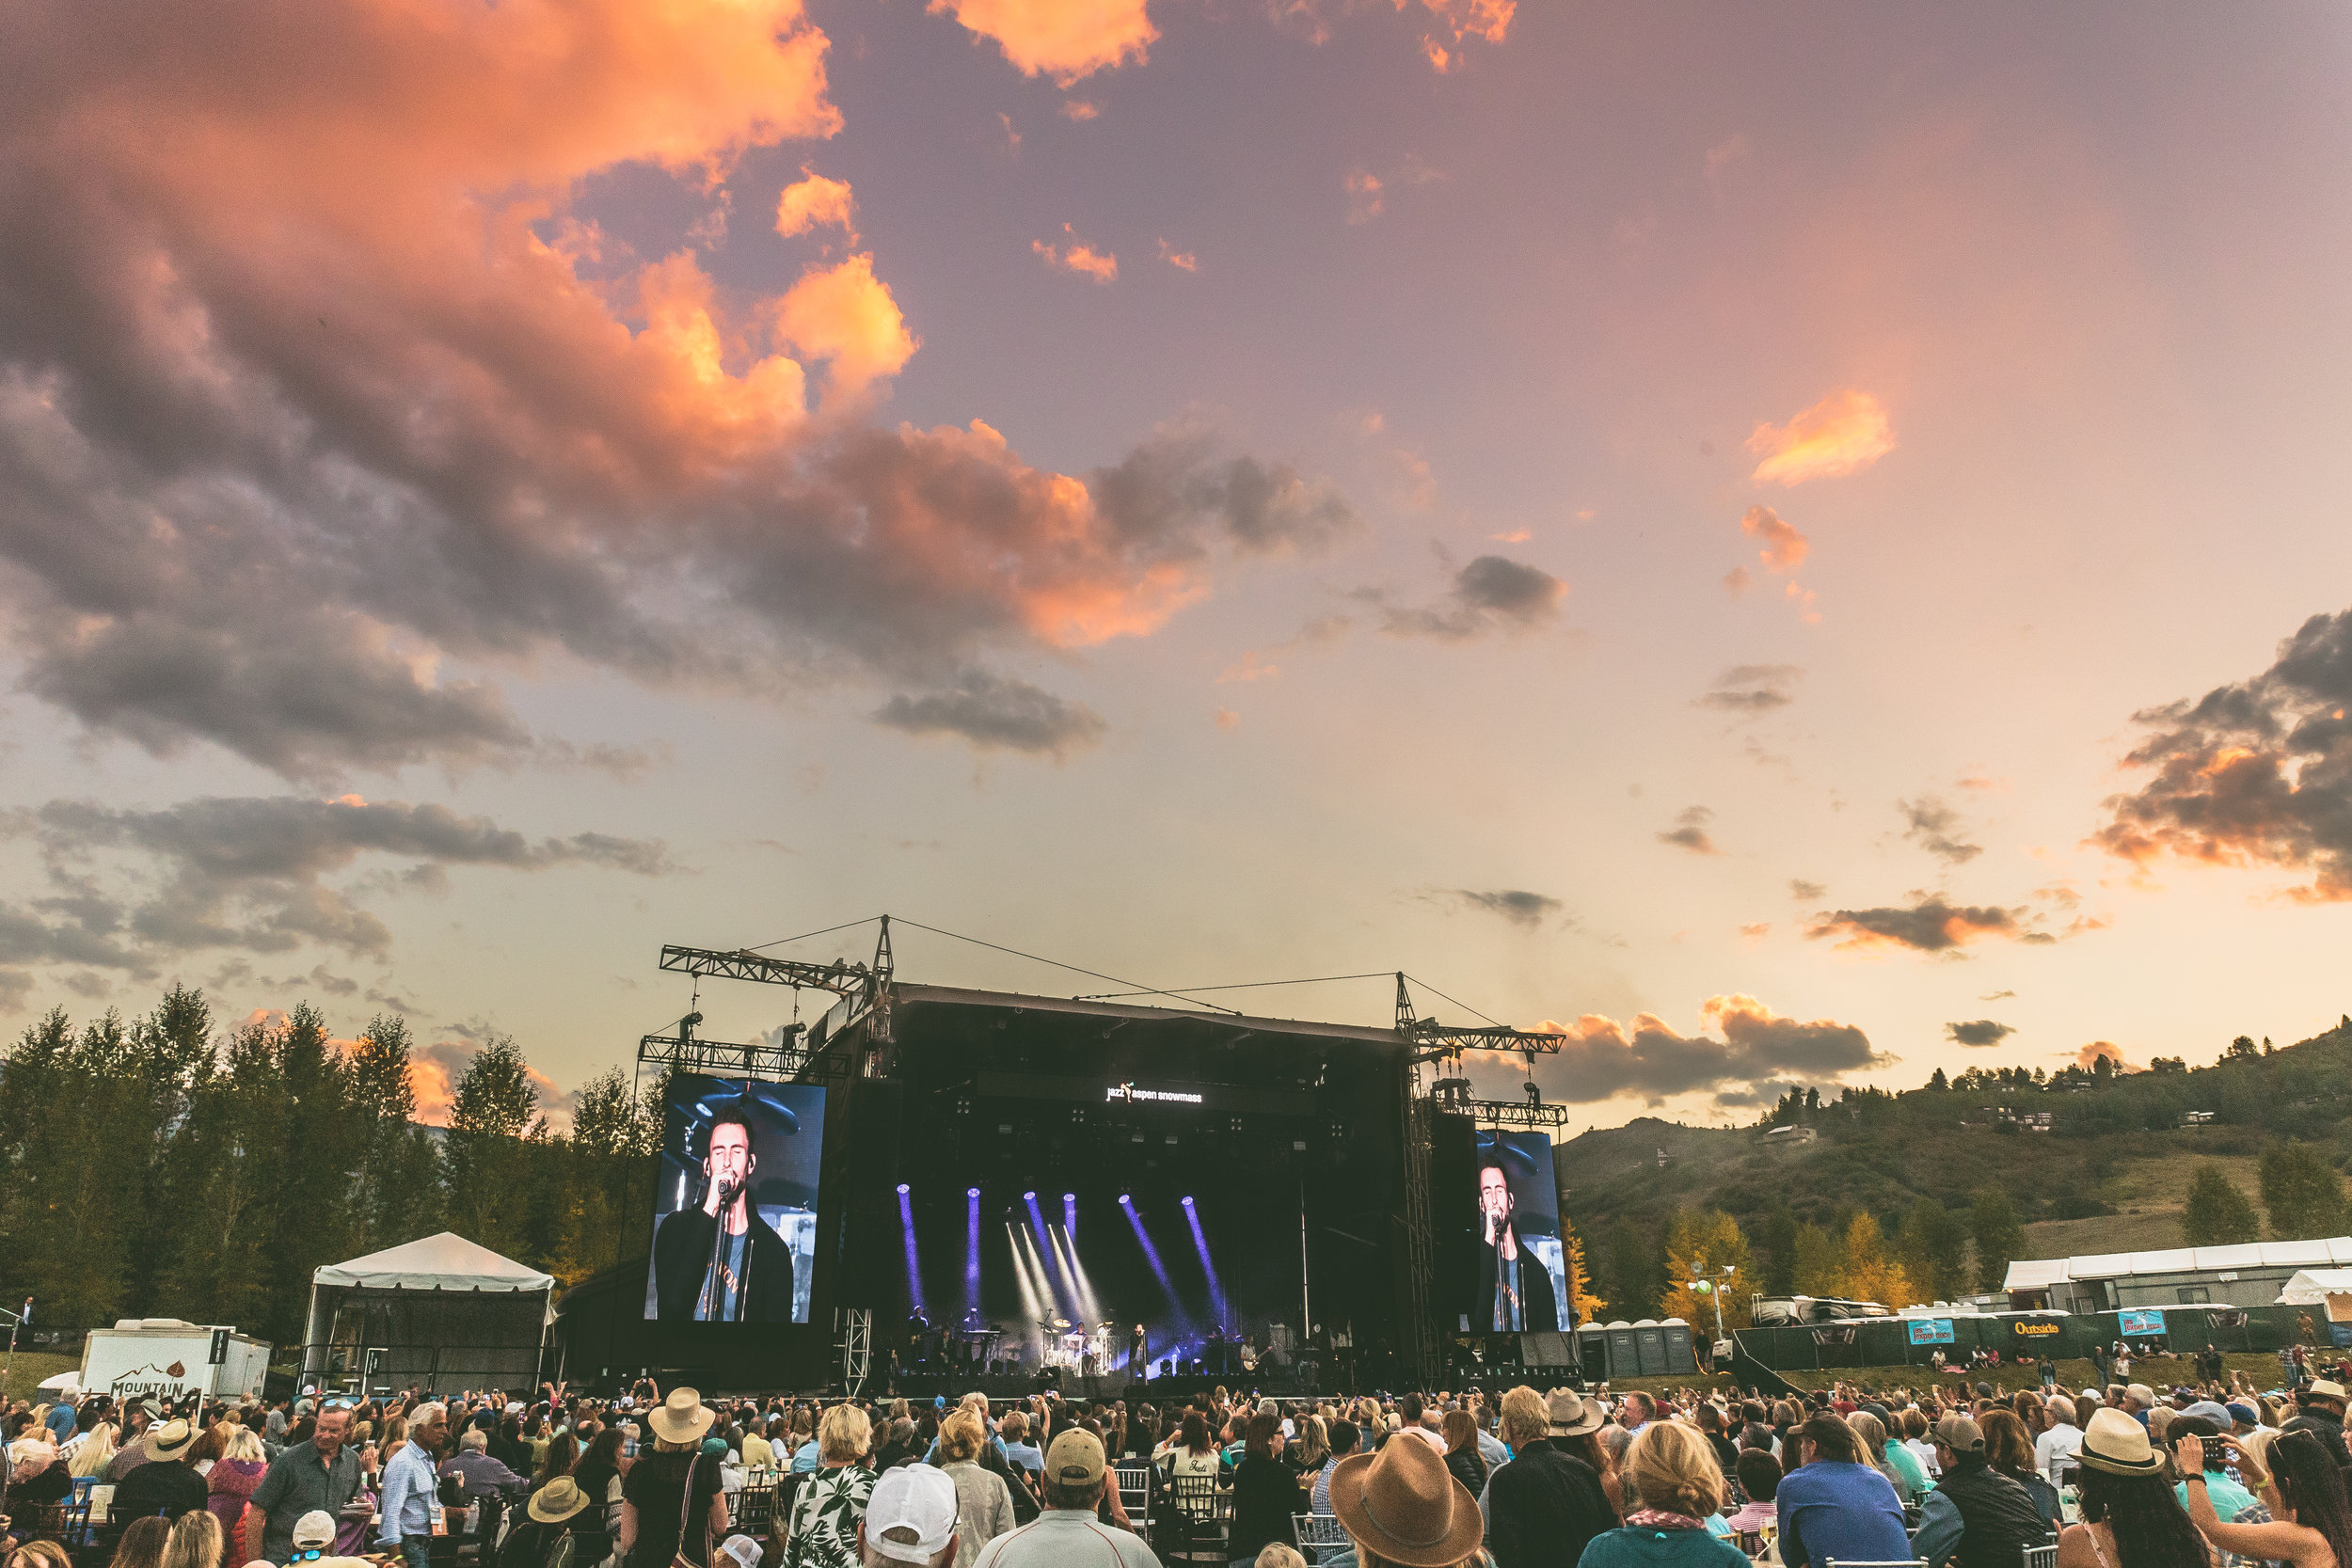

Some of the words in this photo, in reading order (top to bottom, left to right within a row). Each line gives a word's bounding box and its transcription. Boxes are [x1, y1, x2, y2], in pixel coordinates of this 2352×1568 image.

[1106, 1087, 1124, 1101] jazz
[1132, 1089, 1157, 1101] aspen
[1158, 1091, 1202, 1102] snowmass
[2014, 1321, 2059, 1335] Outside
[110, 1382, 183, 1397] MOUNTAIN
